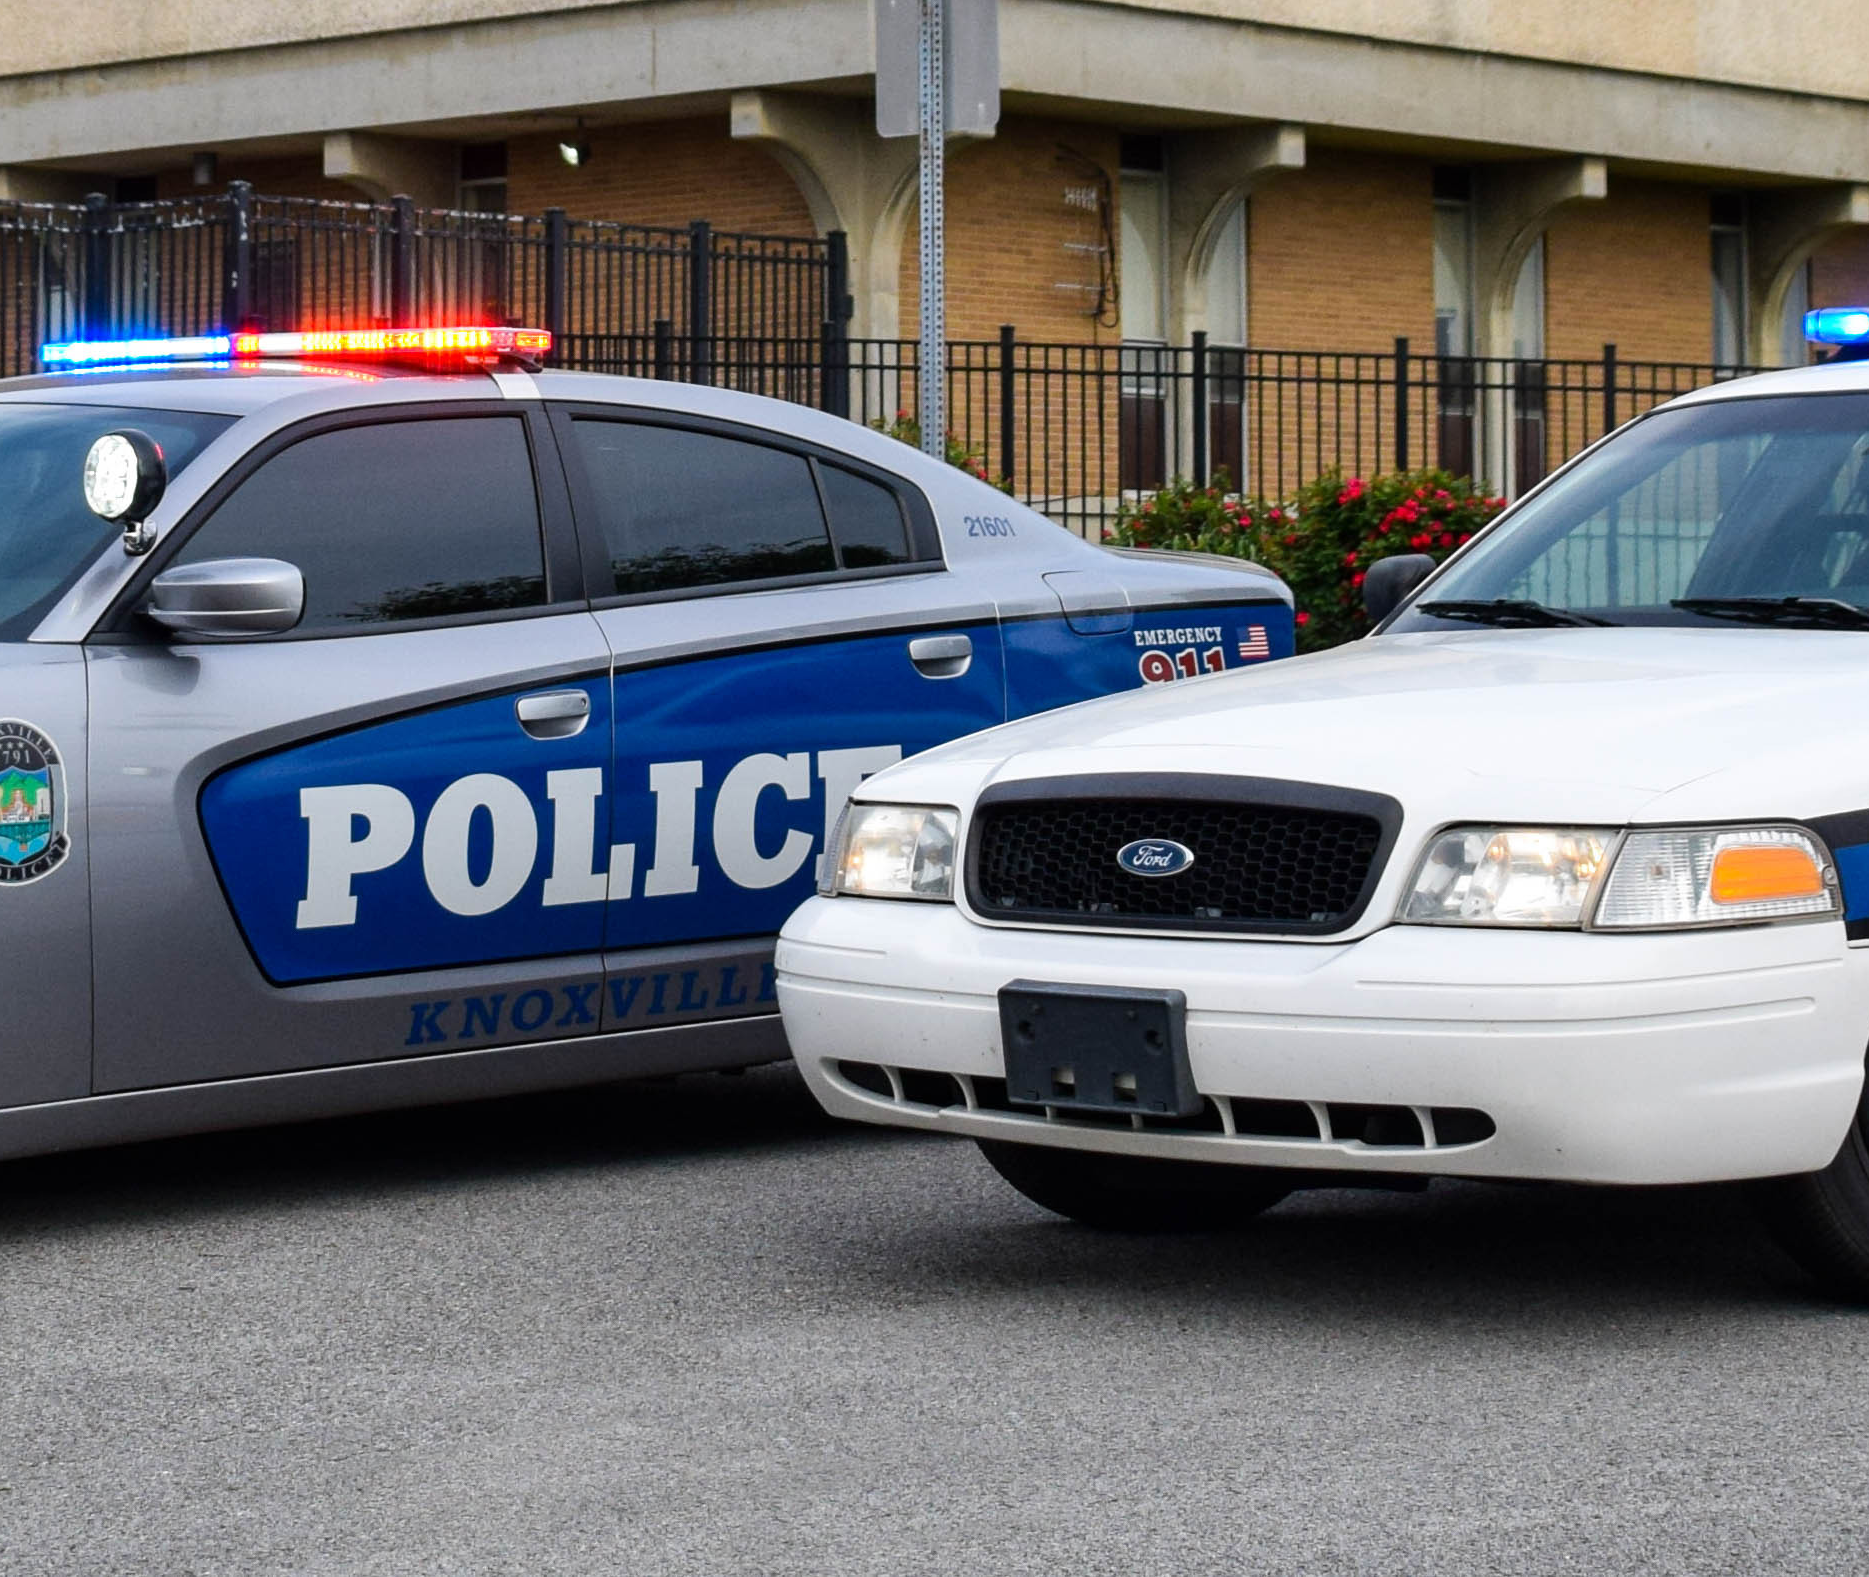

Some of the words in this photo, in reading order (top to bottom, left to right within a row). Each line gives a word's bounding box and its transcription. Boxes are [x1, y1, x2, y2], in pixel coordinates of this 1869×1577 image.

[963, 516, 1016, 537] 21601
[1134, 626, 1222, 646] EMERGENCY
[1133, 845, 1173, 867] Ford
